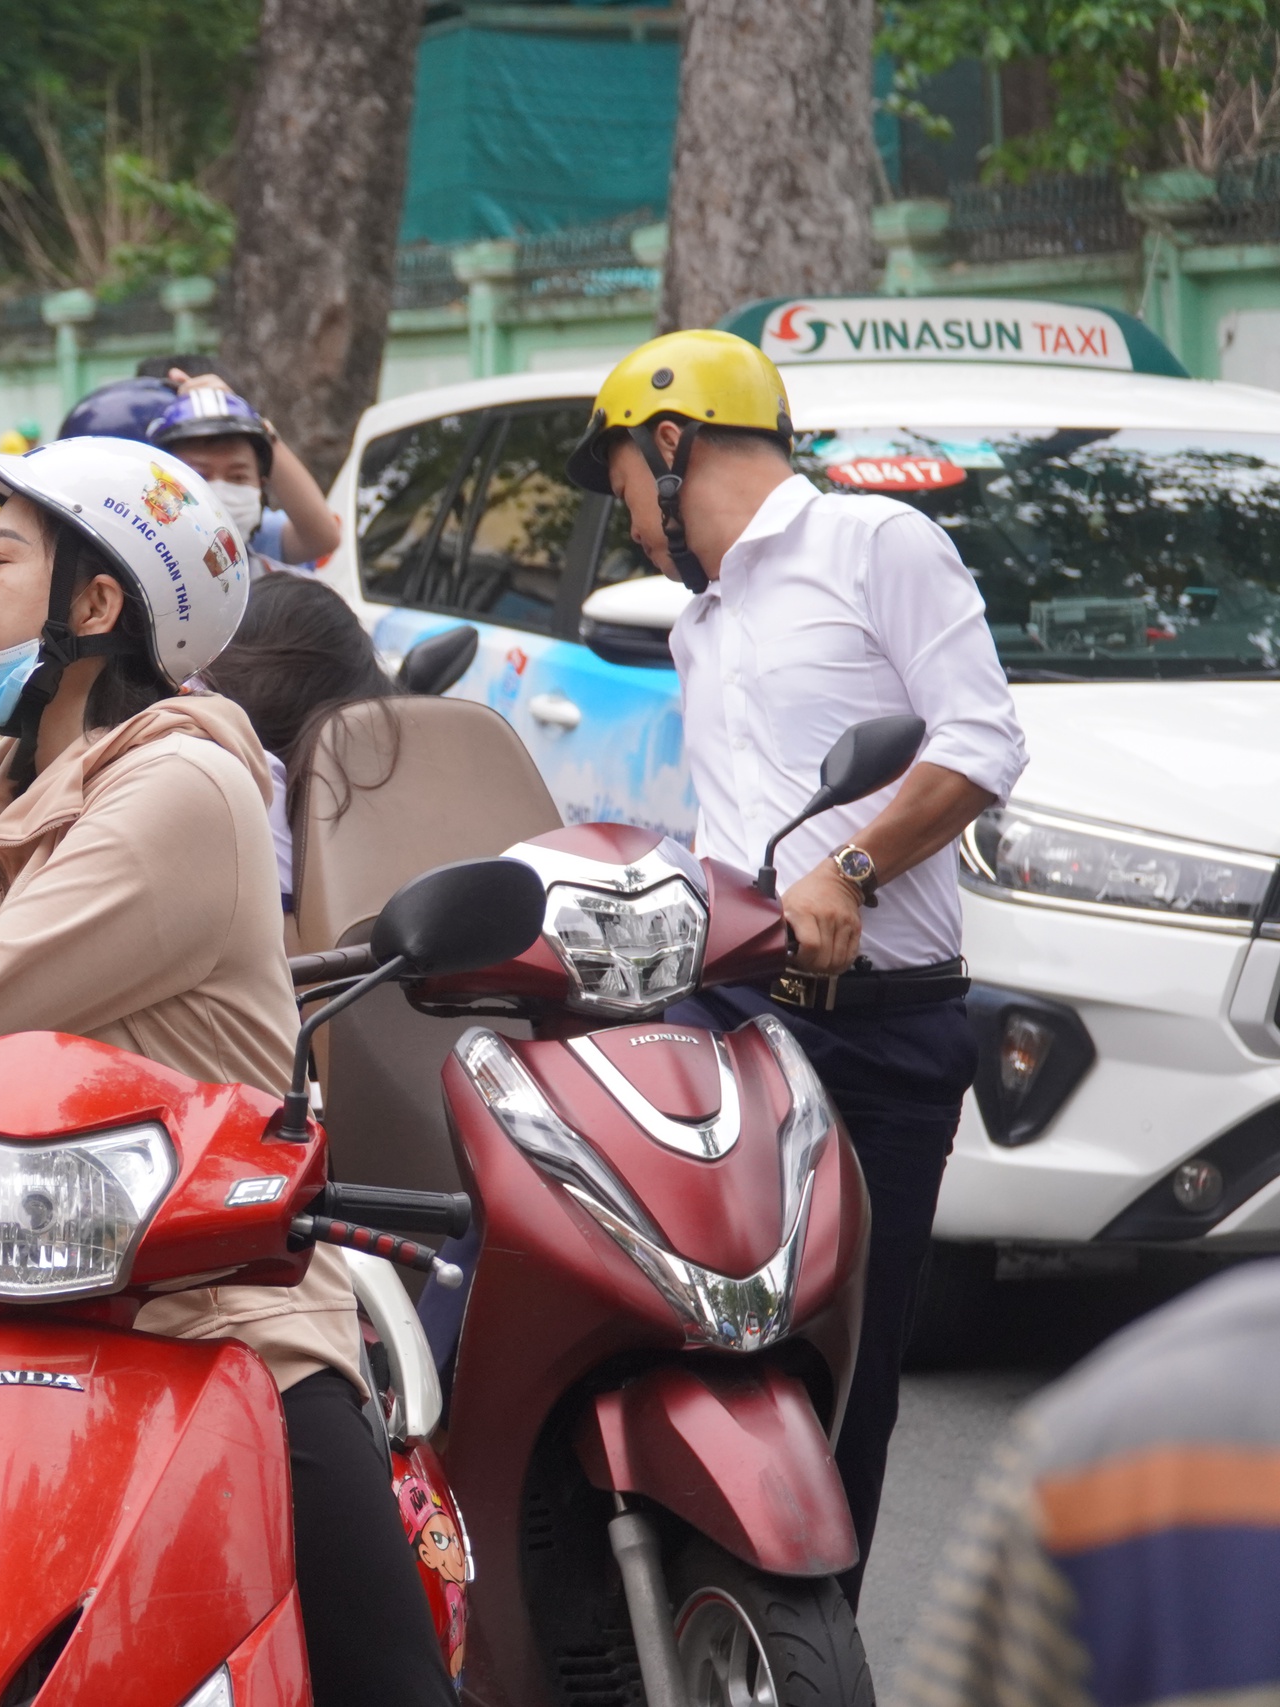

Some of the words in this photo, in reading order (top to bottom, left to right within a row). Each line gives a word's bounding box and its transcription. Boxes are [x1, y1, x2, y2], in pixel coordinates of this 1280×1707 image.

[841, 318, 1022, 352] VINASUN
[1032, 322, 1108, 357] TAXI
[839, 461, 943, 484] 18417
[103, 497, 131, 518] ĐỐI
[131, 514, 157, 541] TÁC
[154, 541, 182, 582] CHÂN
[175, 583, 192, 622] THẬT
[630, 1032, 699, 1046] HONDA
[409, 1486, 428, 1516] KTM
